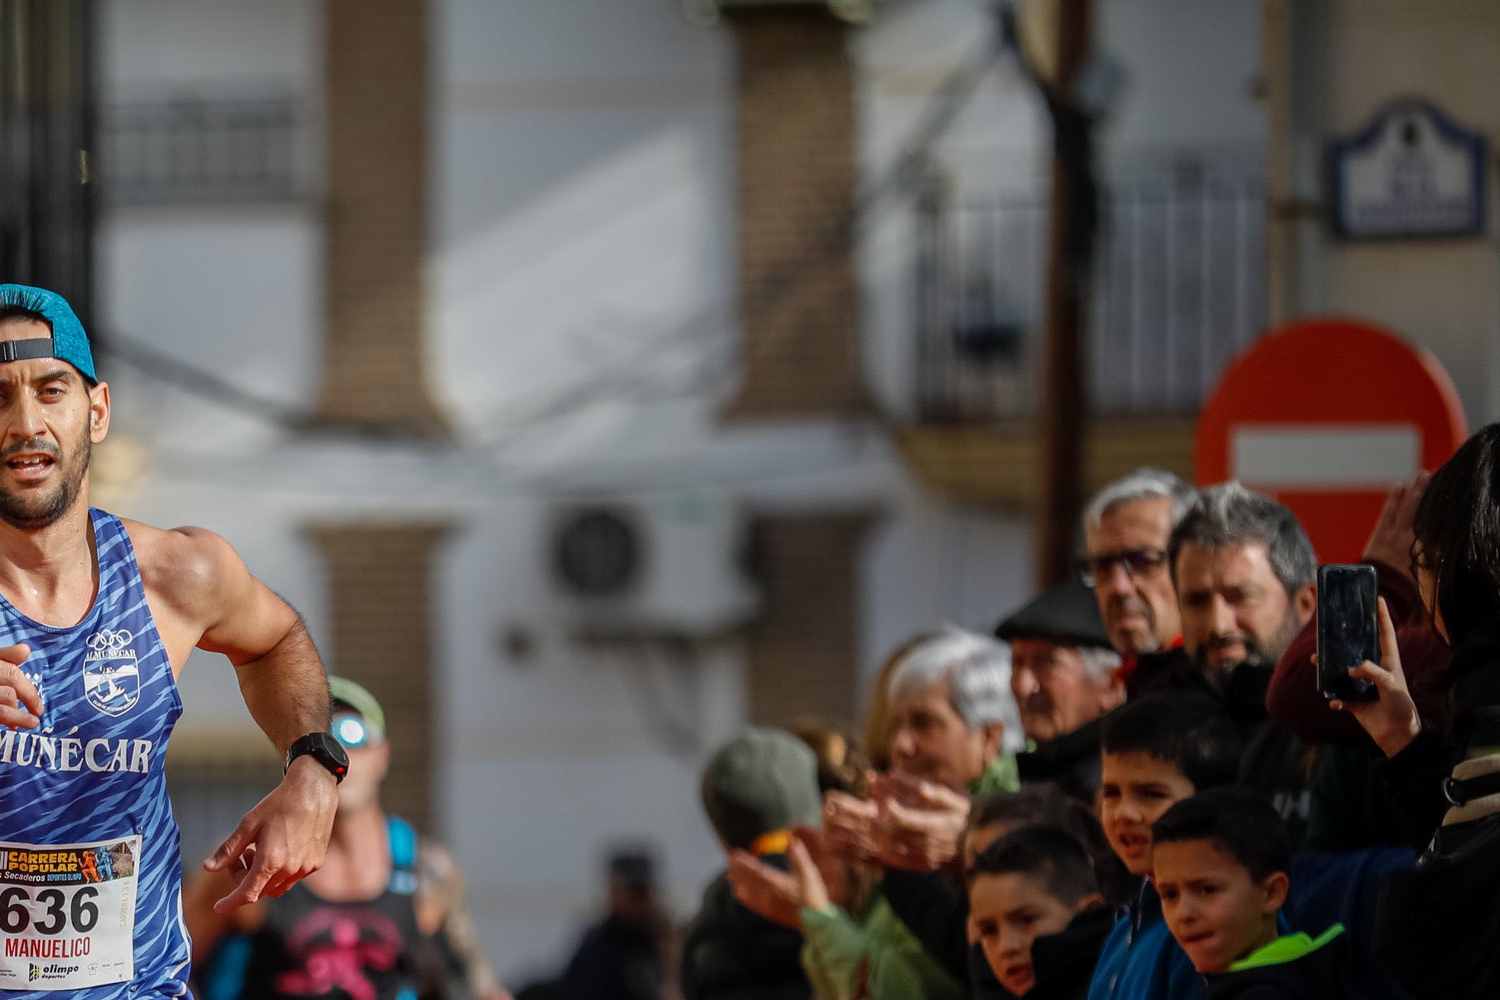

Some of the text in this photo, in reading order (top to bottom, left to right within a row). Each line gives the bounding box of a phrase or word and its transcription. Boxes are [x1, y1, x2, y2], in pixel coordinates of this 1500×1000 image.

[8, 851, 77, 864] CARRERA
[8, 862, 77, 872] POPULAR
[4, 871, 46, 881] Secaderos
[5, 936, 91, 958] MANUELICO
[43, 964, 79, 975] olimpo
